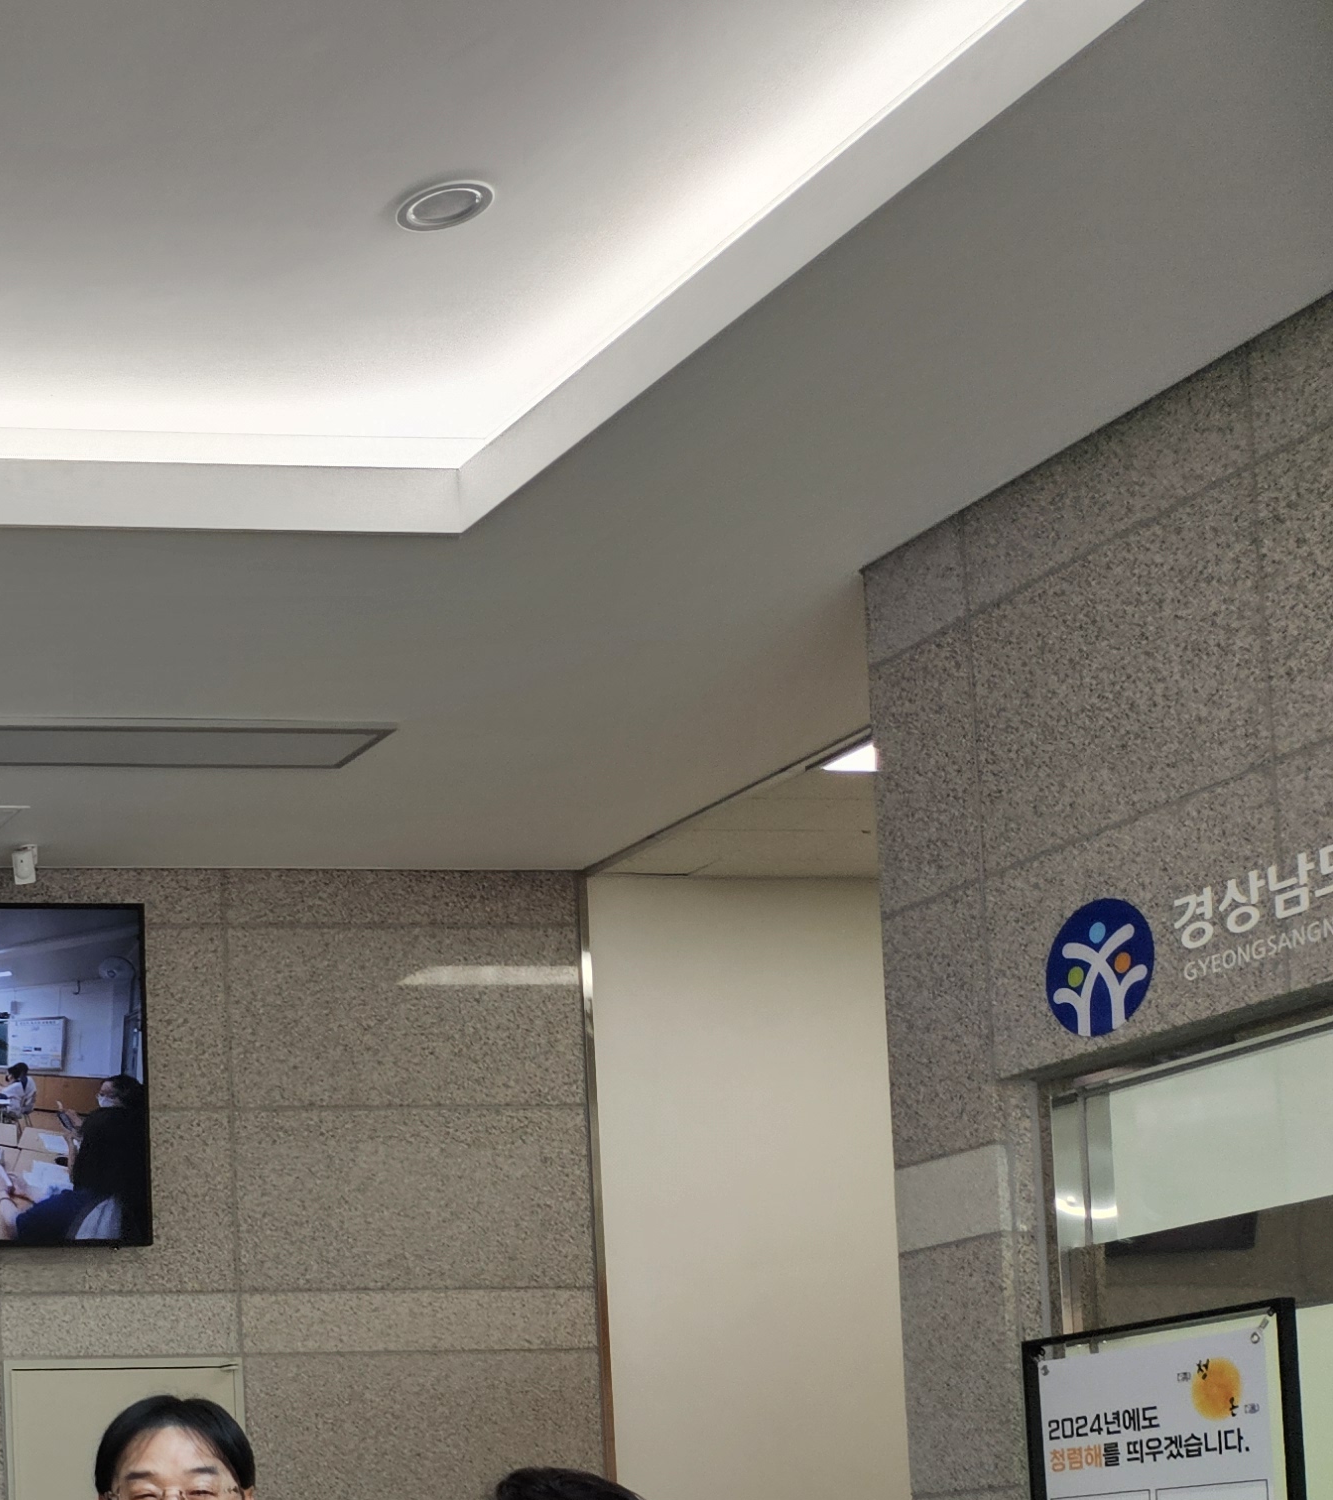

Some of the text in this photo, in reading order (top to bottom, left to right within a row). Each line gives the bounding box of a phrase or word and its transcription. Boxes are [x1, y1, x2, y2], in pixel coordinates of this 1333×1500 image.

[1048, 1406, 1161, 1441] 2024년에도
[1049, 1428, 1250, 1473] 청렴해를 띄우겠습니다.
